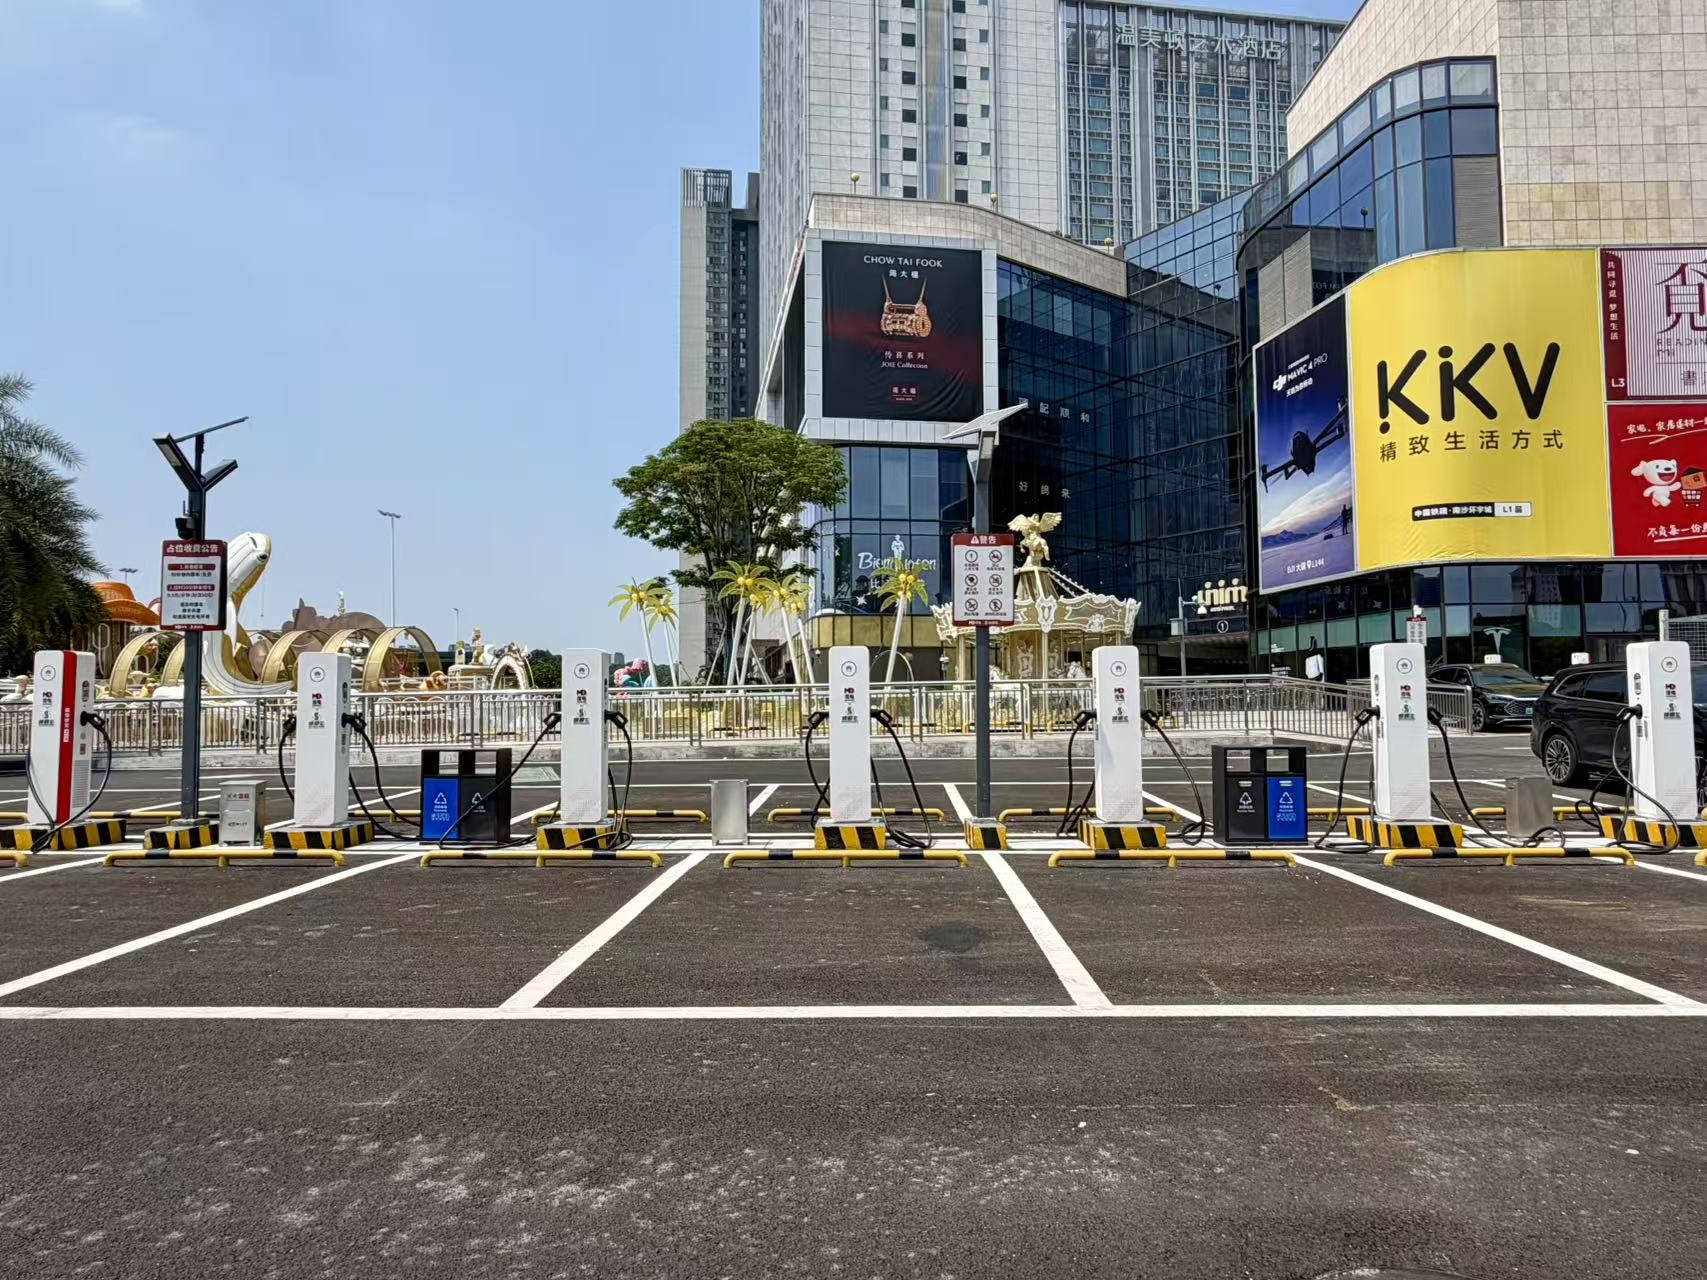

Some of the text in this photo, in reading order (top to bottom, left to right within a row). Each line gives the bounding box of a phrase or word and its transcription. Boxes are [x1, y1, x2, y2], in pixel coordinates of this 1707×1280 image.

[863, 255, 943, 268] CHOW TAI FOOK
[1287, 364, 1308, 382] MAVIC
[1307, 360, 1313, 370] 4
[1313, 352, 1328, 367] PRO
[1611, 378, 1625, 388] L3
[1379, 429, 1564, 463] 精致生活方式
